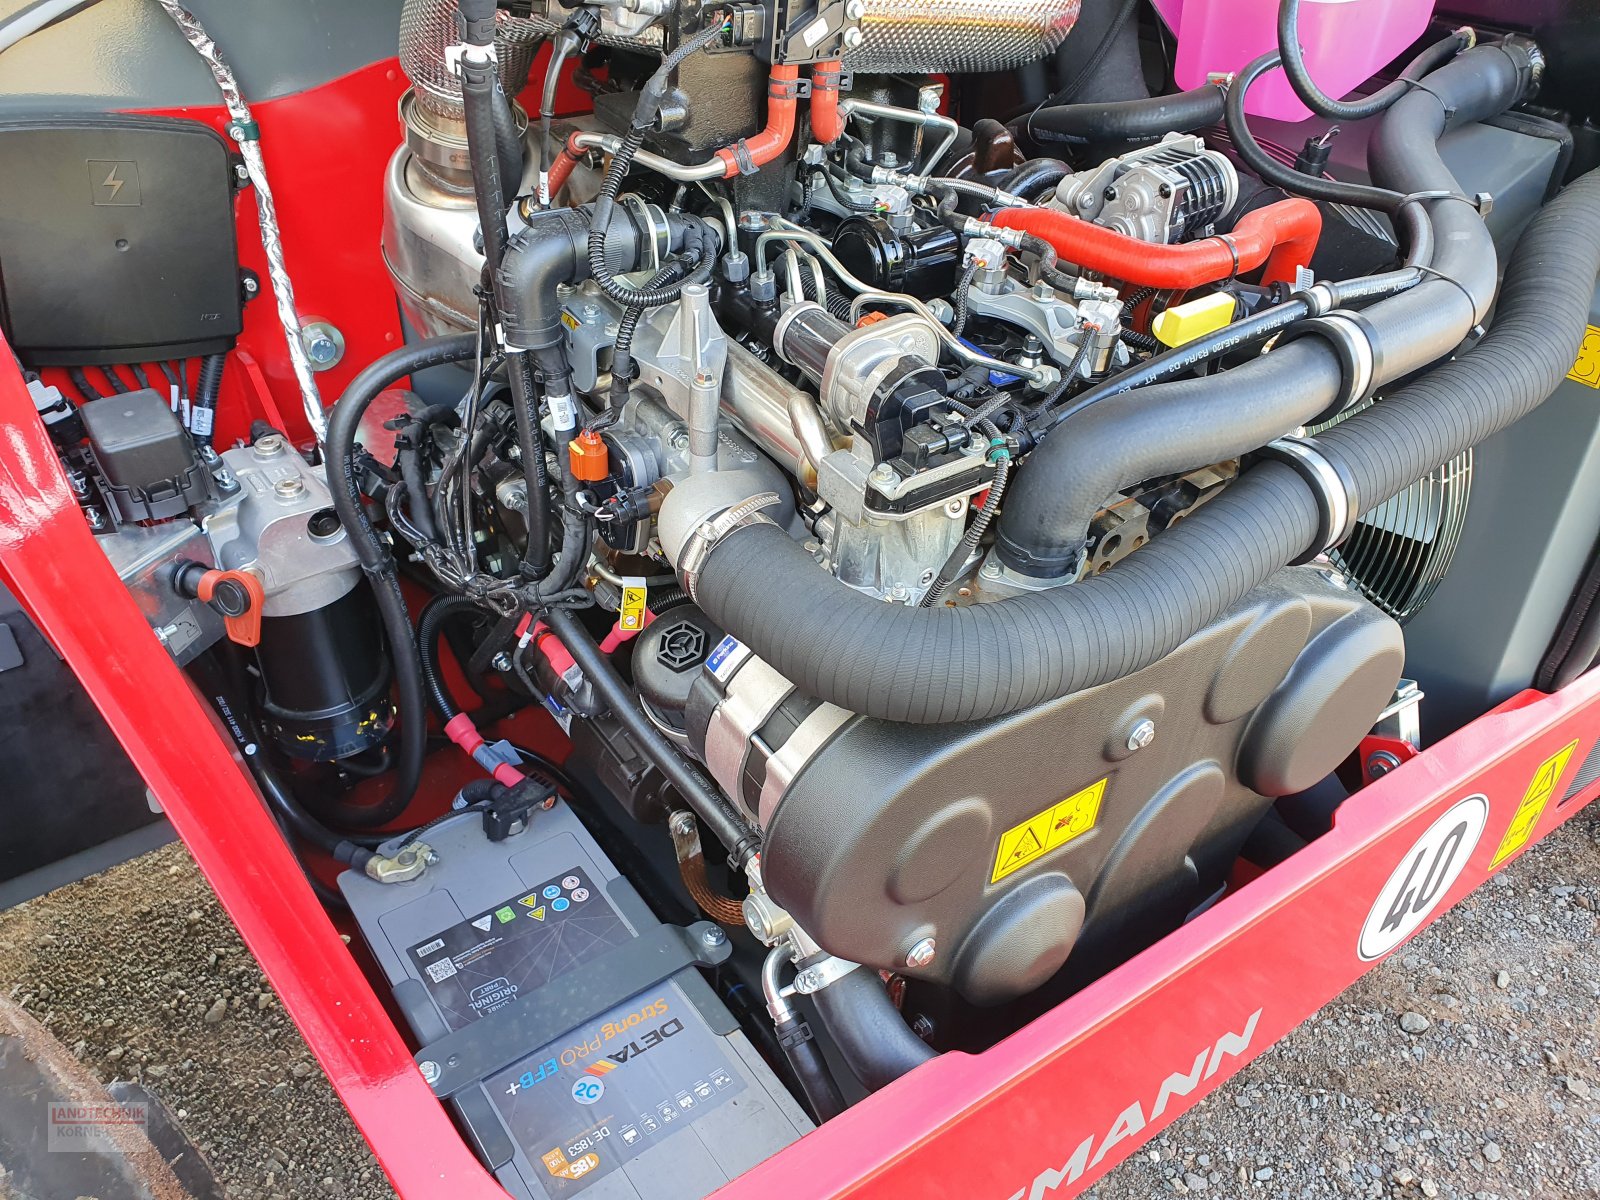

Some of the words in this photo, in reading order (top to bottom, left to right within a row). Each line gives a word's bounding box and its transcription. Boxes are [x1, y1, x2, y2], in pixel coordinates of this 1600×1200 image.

[1168, 360, 1181, 372] D3
[1144, 372, 1157, 386] HT
[534, 442, 543, 465] 73411
[716, 641, 734, 660] Perkins
[1378, 821, 1468, 933] 40
[468, 984, 519, 1009] ORIGINAL
[480, 982, 499, 995] PART
[601, 998, 669, 1041] Strong
[560, 1033, 602, 1066] PRO
[606, 1017, 685, 1064] DETA
[505, 1057, 559, 1096] EFB+
[1008, 1007, 1263, 1200] MANN
[592, 1126, 611, 1142] DE
[567, 1136, 594, 1157] 1853
[548, 1155, 565, 1168] 1100
[569, 1155, 596, 1178] 185
